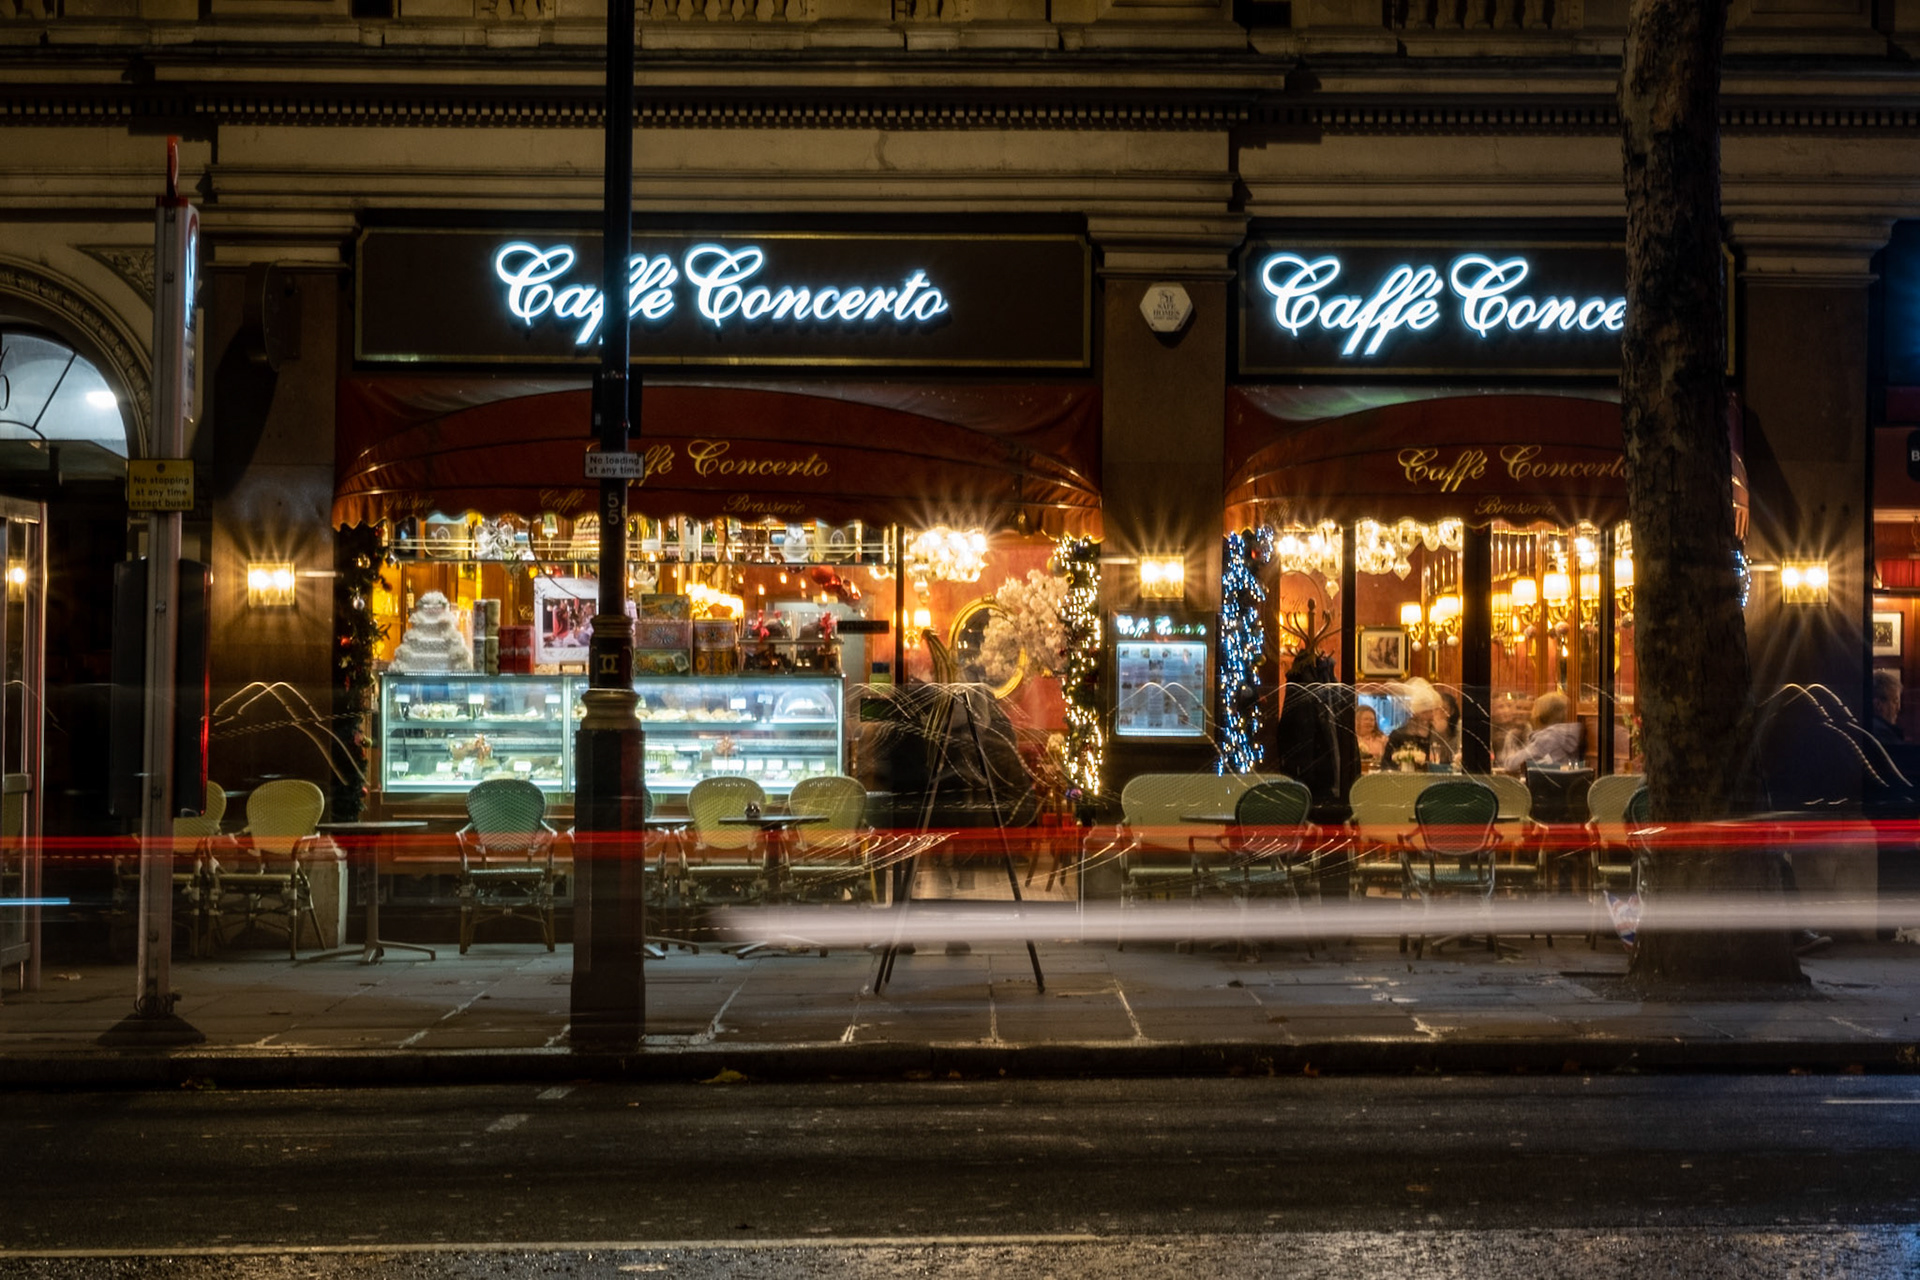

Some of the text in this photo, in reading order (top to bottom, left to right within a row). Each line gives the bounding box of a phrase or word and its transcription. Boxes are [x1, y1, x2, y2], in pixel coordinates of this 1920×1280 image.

[684, 244, 950, 328] Concerto
[1259, 252, 1443, 357] Caffé
[589, 455, 640, 465] No loading
[600, 467, 617, 475] any
[687, 440, 831, 477] Concerto
[1397, 447, 1488, 492] Caffé
[133, 476, 190, 485] No stopping
[722, 493, 805, 515] Brasserie
